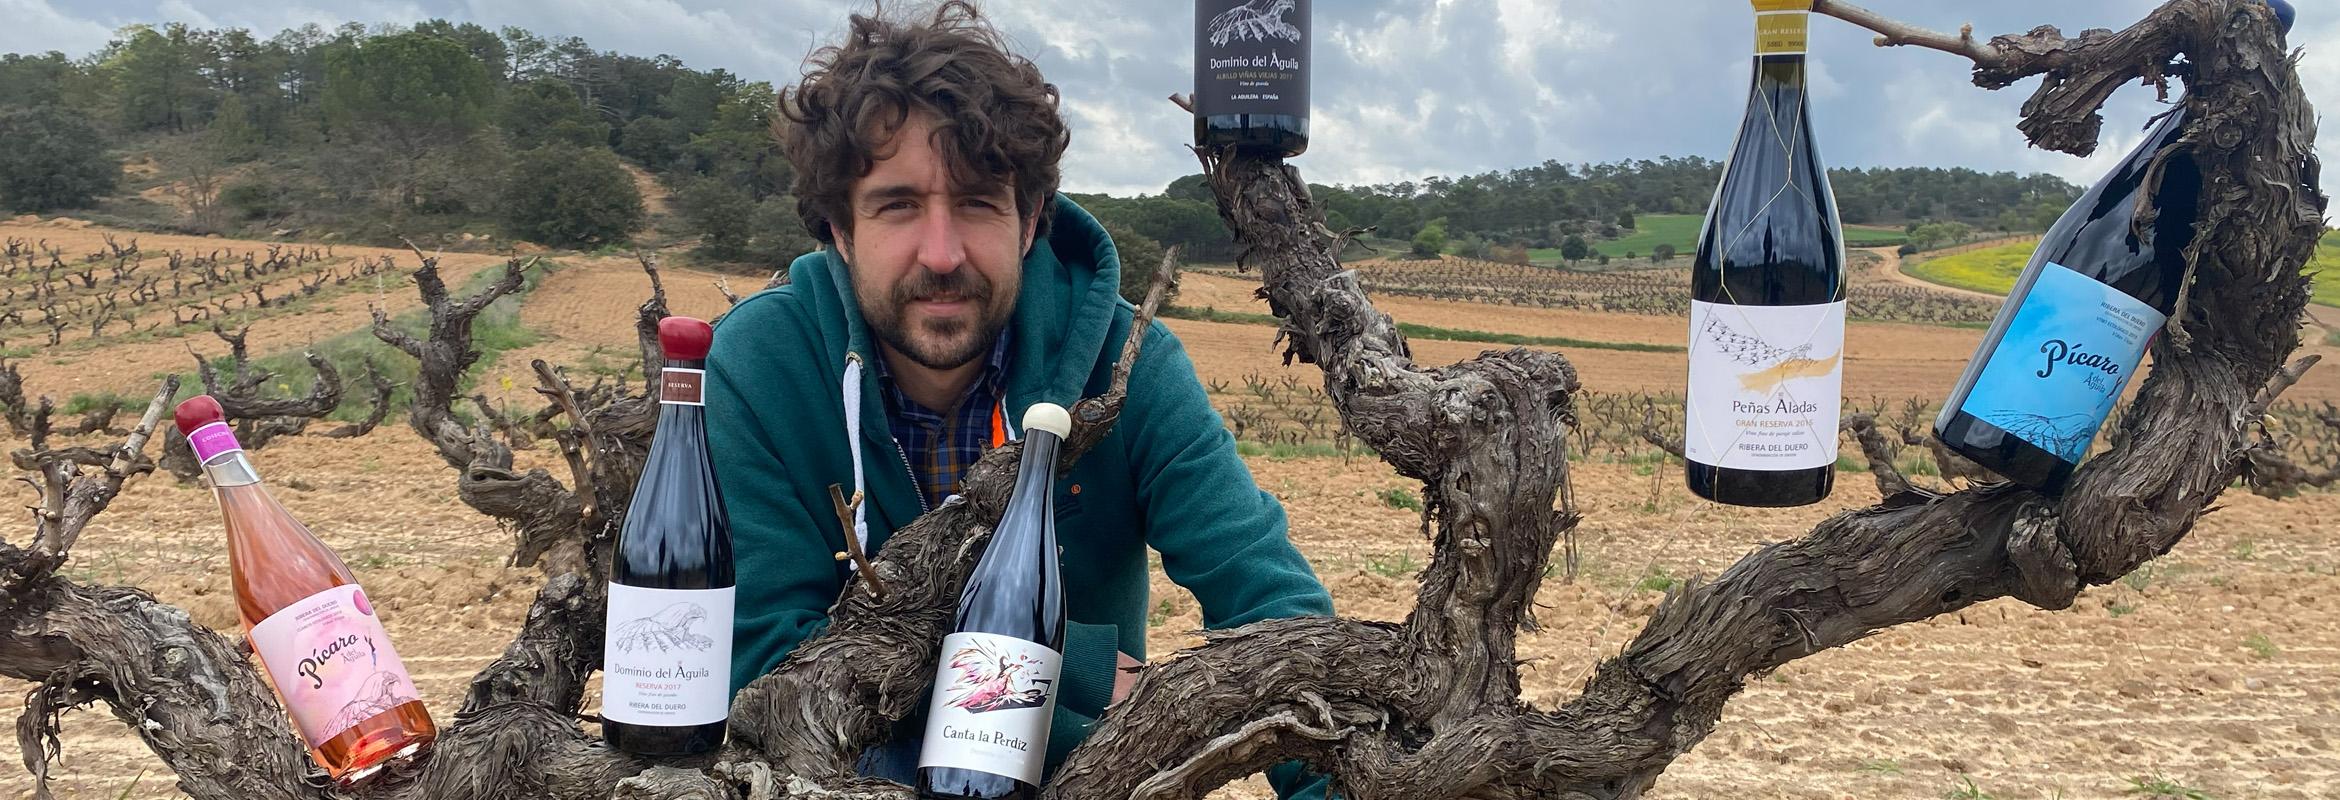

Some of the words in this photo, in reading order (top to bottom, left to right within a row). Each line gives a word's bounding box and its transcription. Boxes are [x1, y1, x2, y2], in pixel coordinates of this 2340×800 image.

[1210, 56, 1249, 69] Dominio
[1252, 55, 1267, 67] del
[1239, 70, 1257, 79] VIÑAS
[1259, 71, 1277, 79] VIEJAS
[2101, 302, 2120, 314] RIBERA
[2121, 311, 2130, 320] DEL
[2131, 316, 2146, 327] DUERO
[2037, 339, 2120, 378] Pícaro
[2093, 373, 2104, 384] del
[1733, 400, 1770, 414] Peñas
[1736, 420, 1758, 428] GRAN
[1760, 420, 1793, 428] RESERVA
[1739, 443, 1766, 451] RIBERA
[1768, 444, 1783, 452] DEL
[1784, 443, 1809, 451] DUERO
[347, 648, 356, 657] del
[298, 634, 358, 689] Pícaro
[614, 663, 652, 678] Dominio
[655, 668, 671, 679] del
[635, 682, 662, 690] RESERVA
[629, 701, 650, 709] RIBERA
[943, 725, 975, 740] Canta
[978, 730, 990, 742] la
[993, 731, 1028, 752] Perdiz
